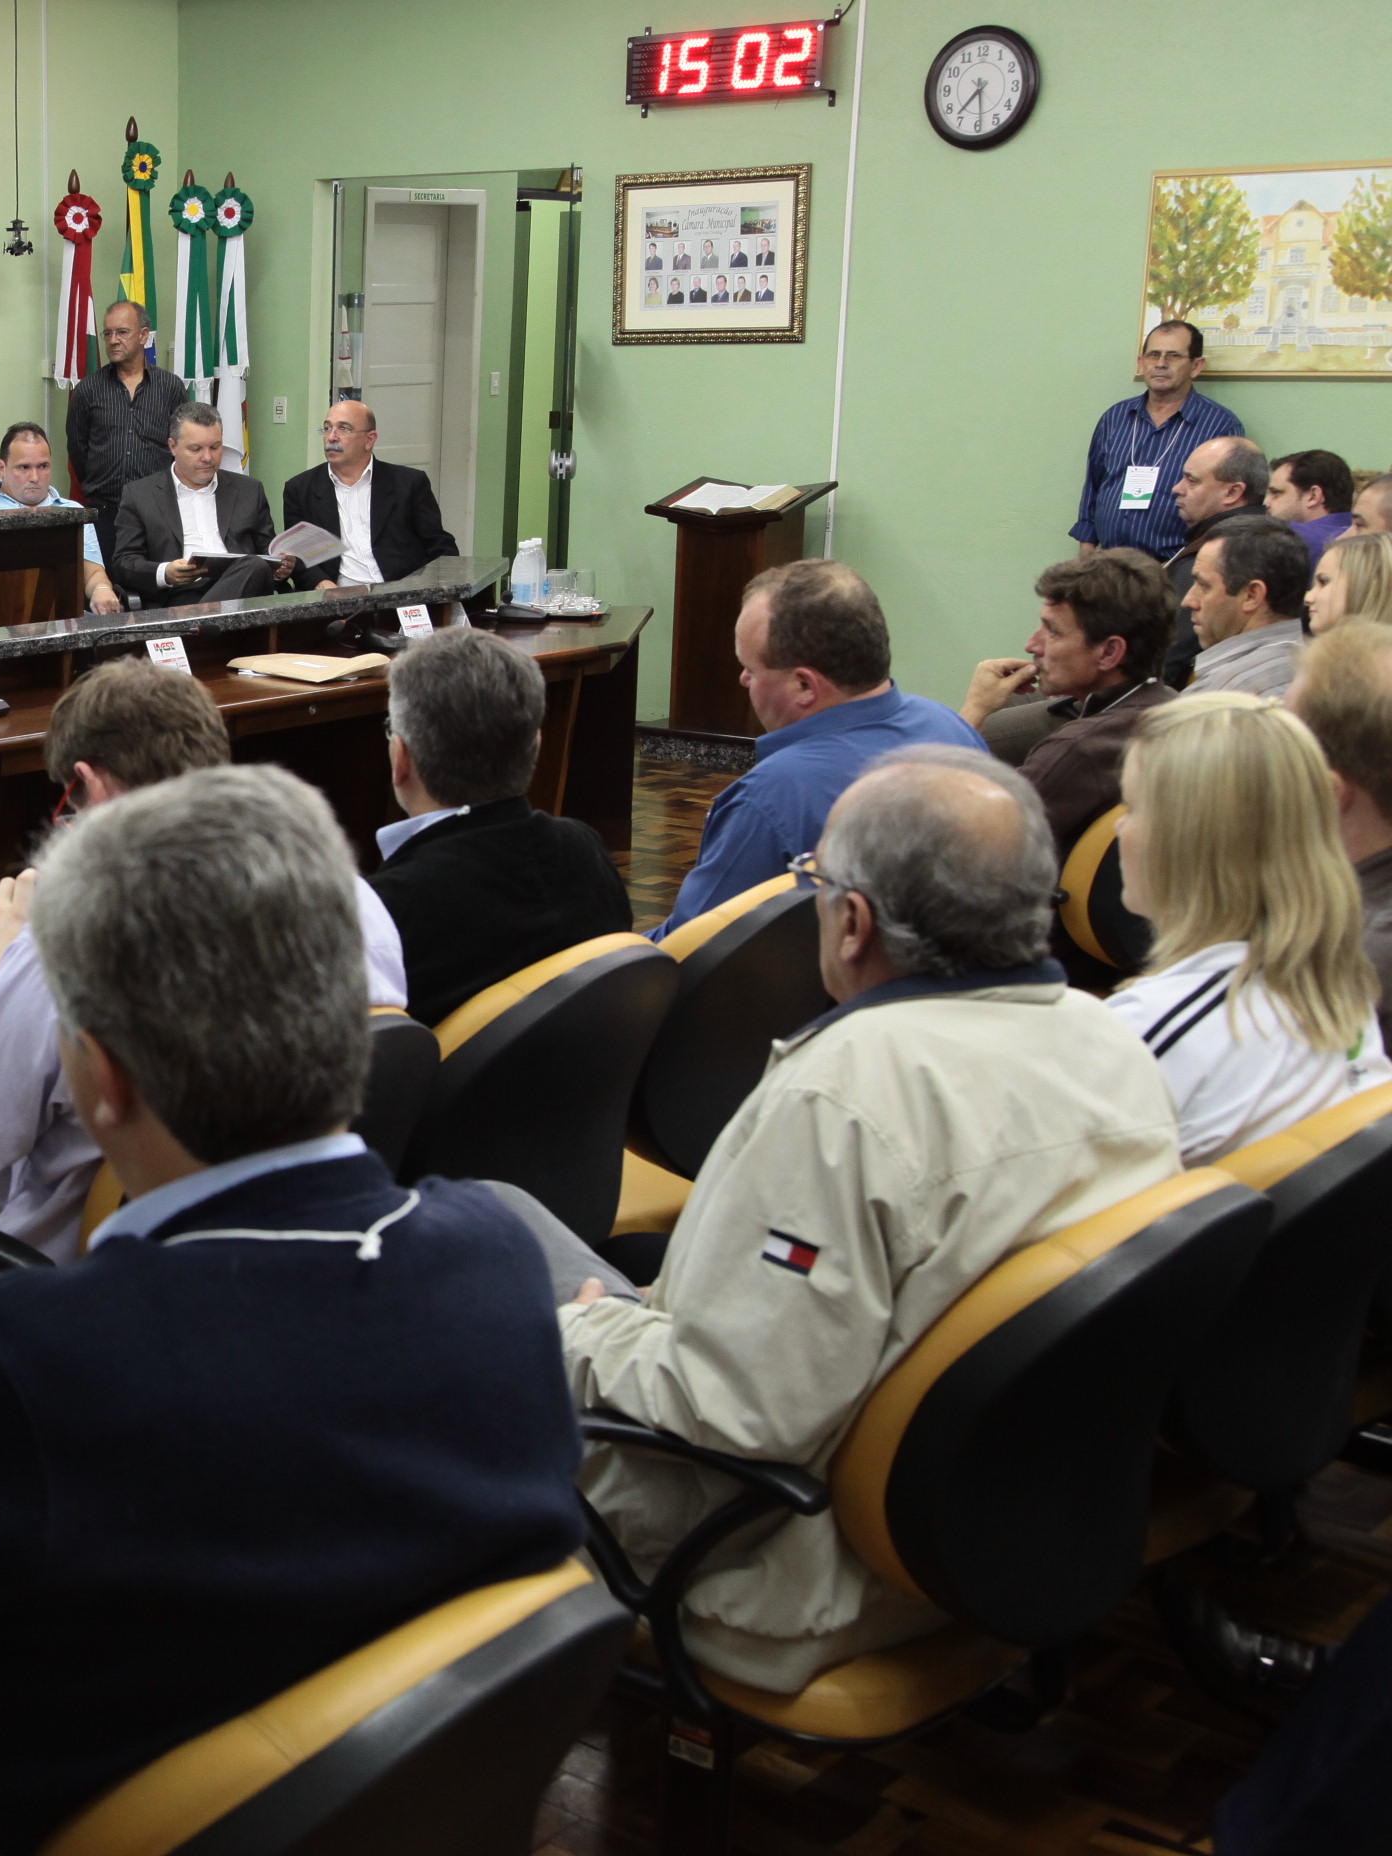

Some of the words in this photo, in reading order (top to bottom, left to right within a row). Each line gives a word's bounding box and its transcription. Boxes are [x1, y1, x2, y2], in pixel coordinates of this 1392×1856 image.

[961, 50, 972, 63] 11
[977, 45, 989, 57] 12
[998, 49, 1003, 61] 1
[658, 37, 710, 94] 15
[731, 27, 813, 90] 02
[1008, 61, 1016, 73] 2
[948, 66, 960, 78] 10
[943, 84, 951, 97] 9
[1011, 79, 1020, 92] 3
[946, 102, 953, 115] 8
[1004, 98, 1012, 111] 4
[956, 116, 964, 129] 7
[974, 119, 982, 133] 6
[992, 113, 1000, 126] 5
[414, 192, 446, 201] SECRETARIA
